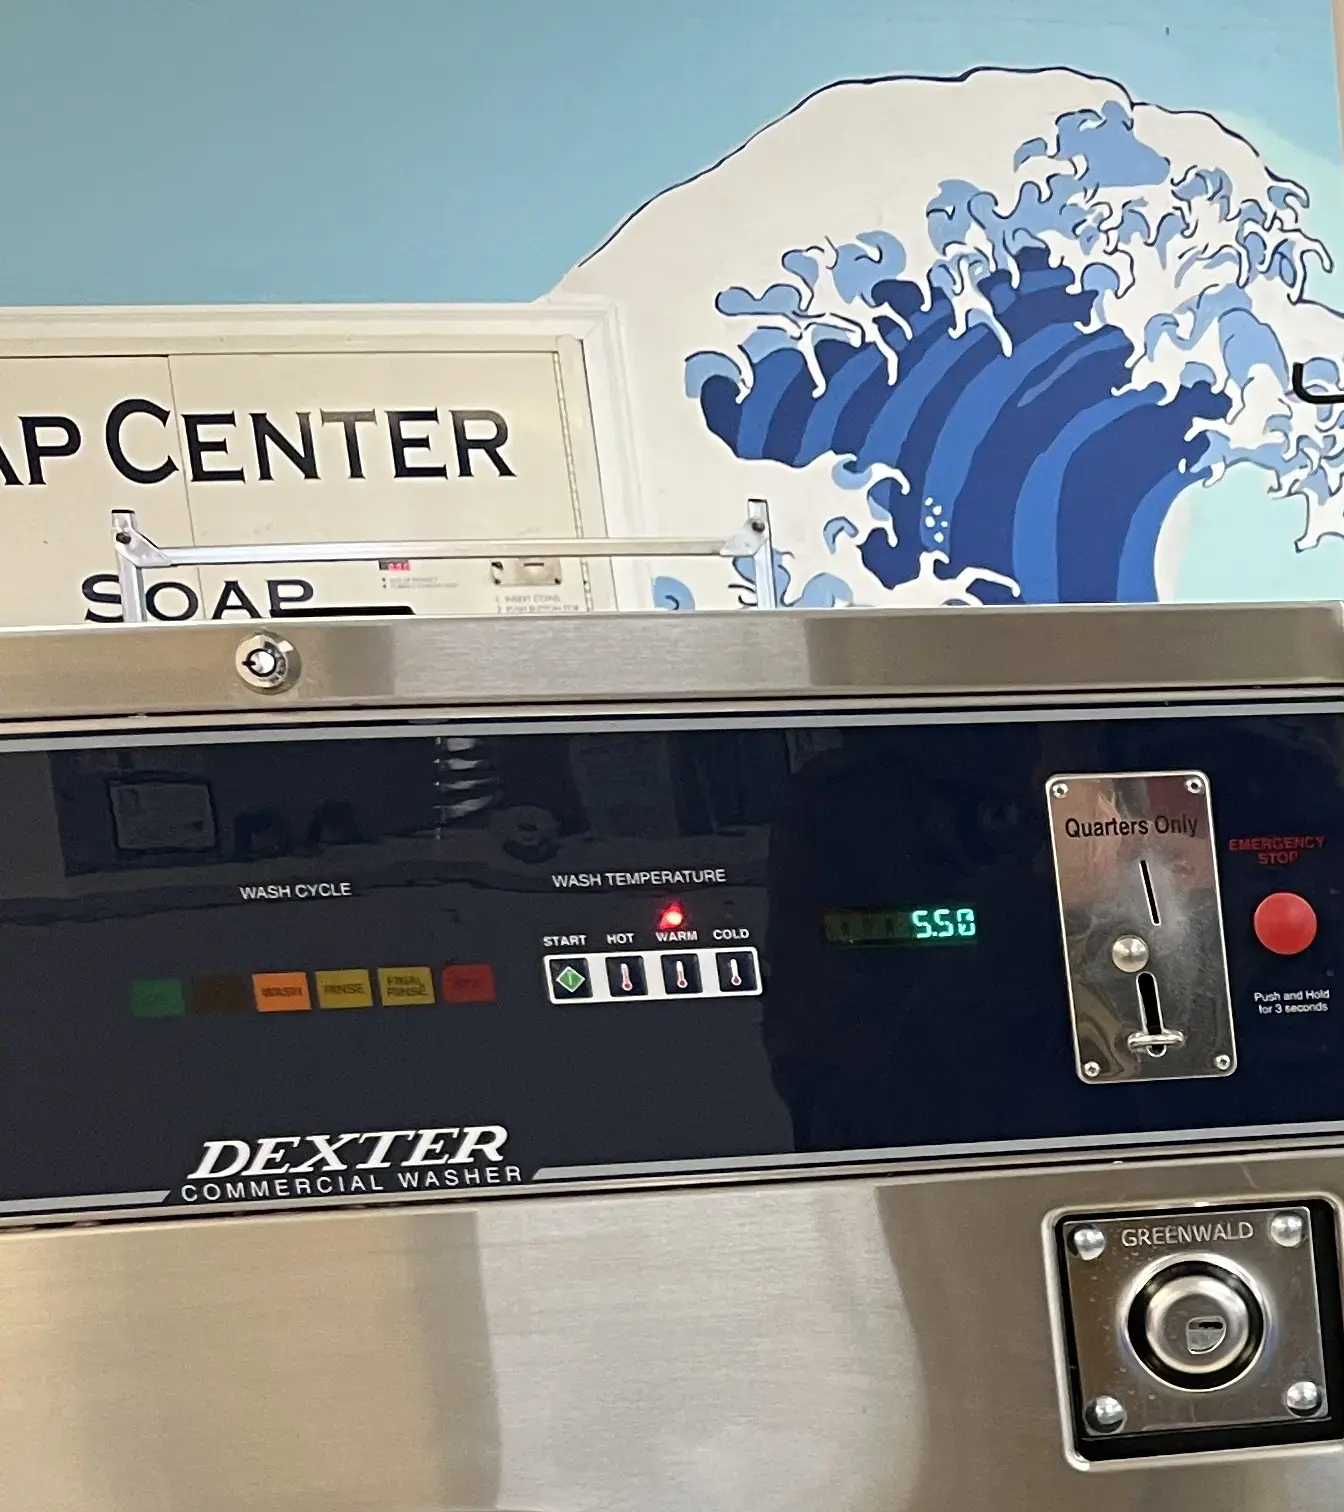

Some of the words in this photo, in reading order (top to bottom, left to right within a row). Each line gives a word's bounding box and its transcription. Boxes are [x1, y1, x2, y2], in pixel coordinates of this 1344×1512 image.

[105, 398, 516, 484] CENTER
[1065, 818, 1148, 838] Quarters
[1154, 815, 1198, 838] Only
[1228, 836, 1326, 851] EMERGENCY
[1258, 851, 1298, 865] STOP
[552, 873, 600, 888] WASH
[605, 869, 726, 886] TEMPERATURE
[240, 884, 291, 900] WASH
[295, 882, 352, 898] CYCLE
[912, 908, 976, 938] 5.50
[543, 935, 587, 947] START
[607, 933, 634, 944] HOT
[655, 930, 698, 942] WARM
[713, 929, 749, 940] COLD
[1253, 992, 1281, 1002] Push
[1283, 990, 1303, 1000] and
[1305, 989, 1330, 999] Hold
[1259, 1004, 1272, 1014] for
[1274, 1003, 1282, 1014] 3
[1284, 1002, 1328, 1013] seconds
[187, 1124, 508, 1180] DEXTER
[181, 1176, 384, 1202] COMMERCIAL
[397, 1165, 523, 1188] WASHER
[1121, 1221, 1254, 1247] GREENWALD
